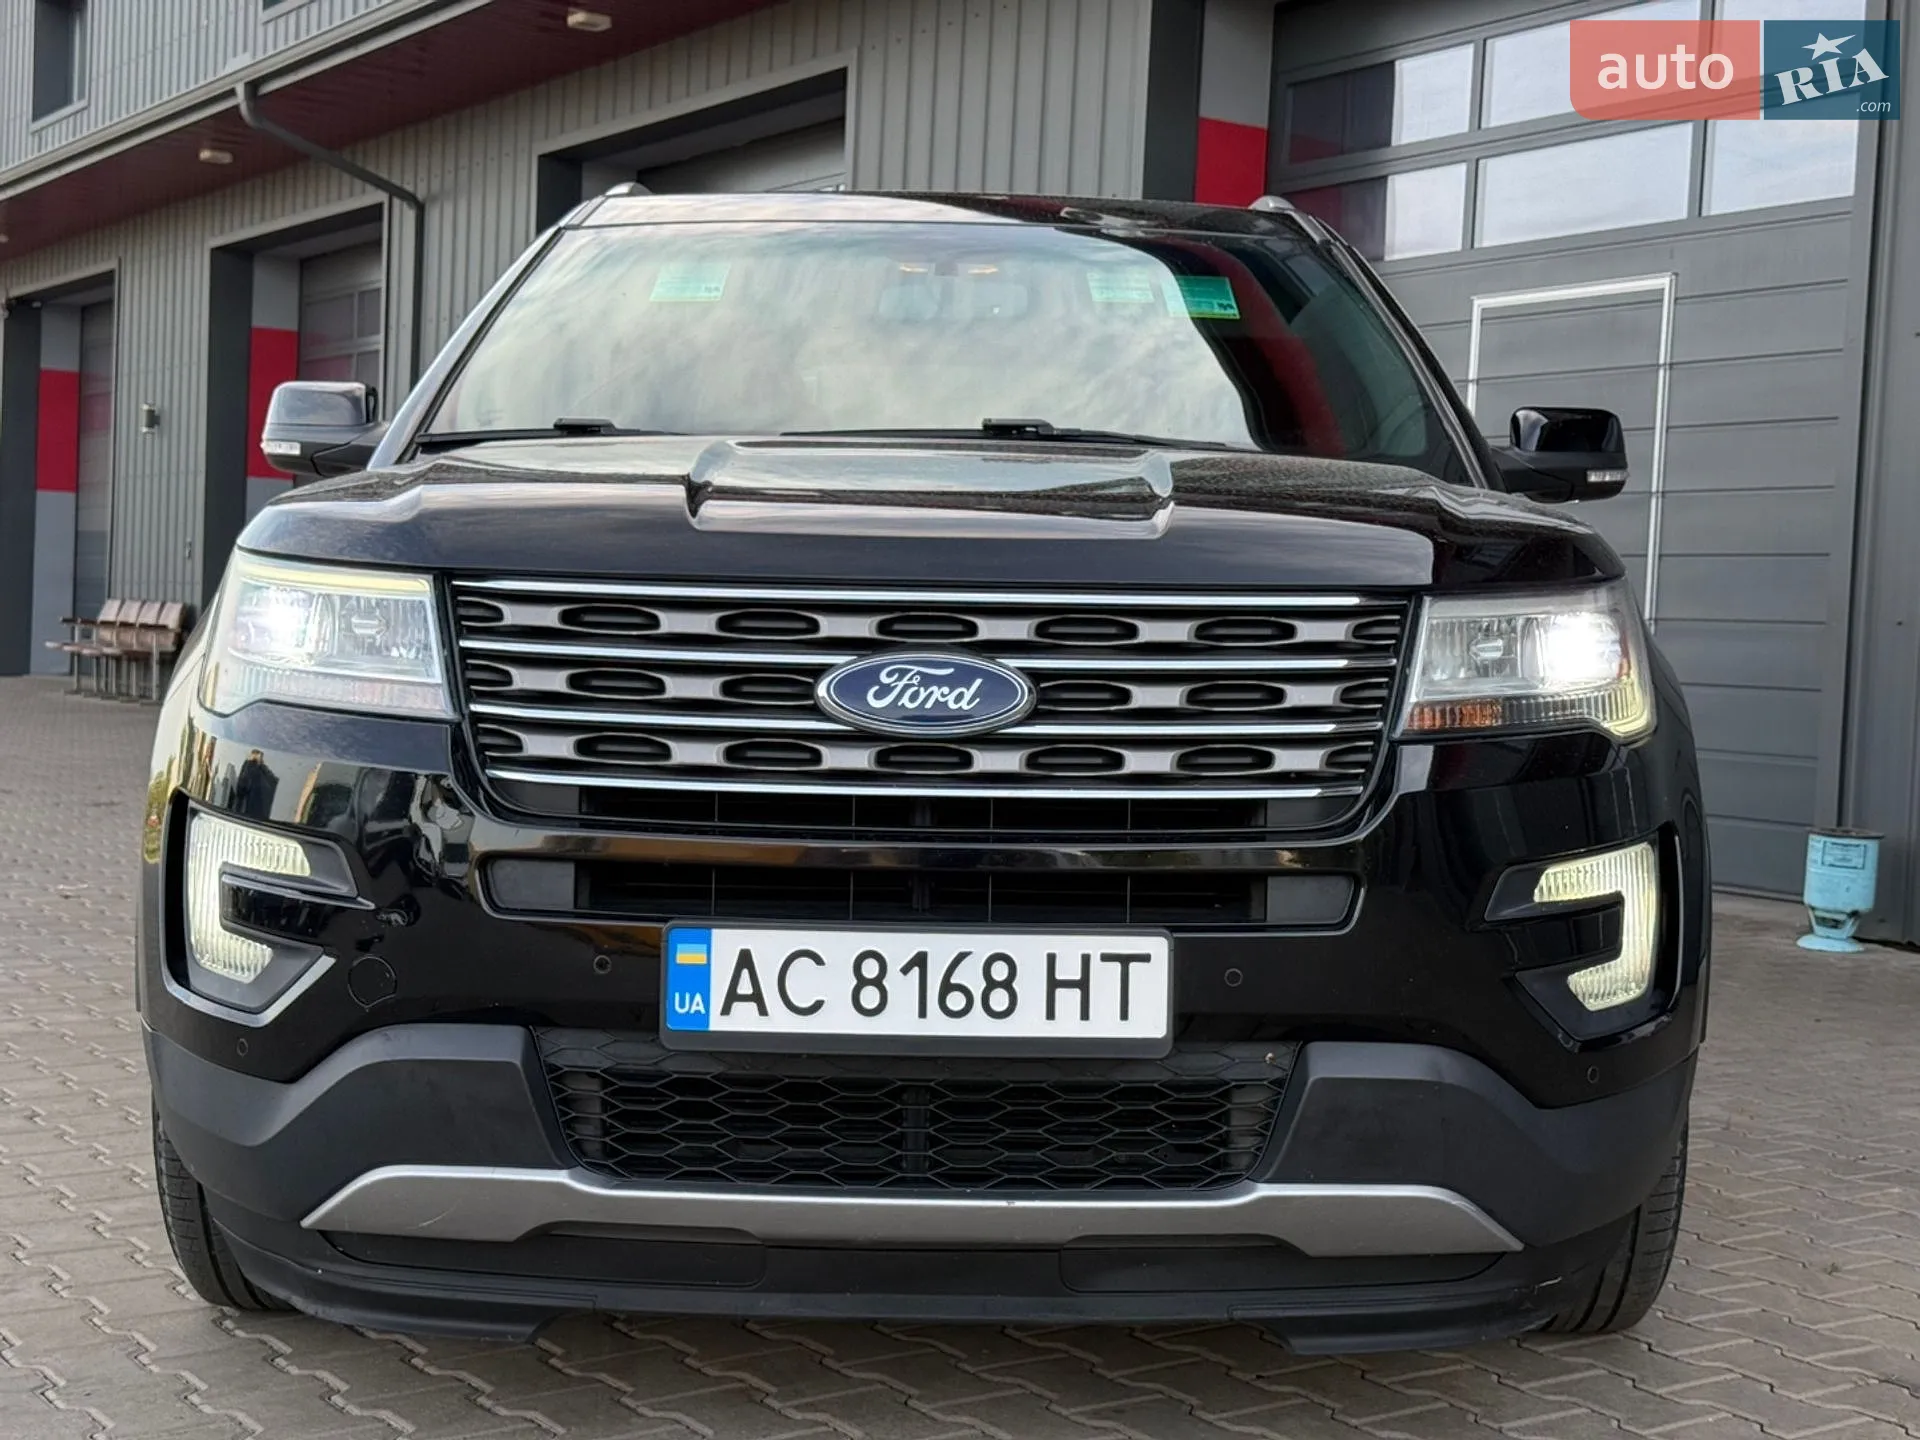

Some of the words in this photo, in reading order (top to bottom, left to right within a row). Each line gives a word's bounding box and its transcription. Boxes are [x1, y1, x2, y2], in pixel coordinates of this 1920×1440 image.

[866, 664, 984, 711] Ford
[674, 992, 706, 1015] UA
[720, 948, 826, 1017] AC
[850, 949, 1018, 1021] 8168
[1045, 951, 1152, 1022] HT
